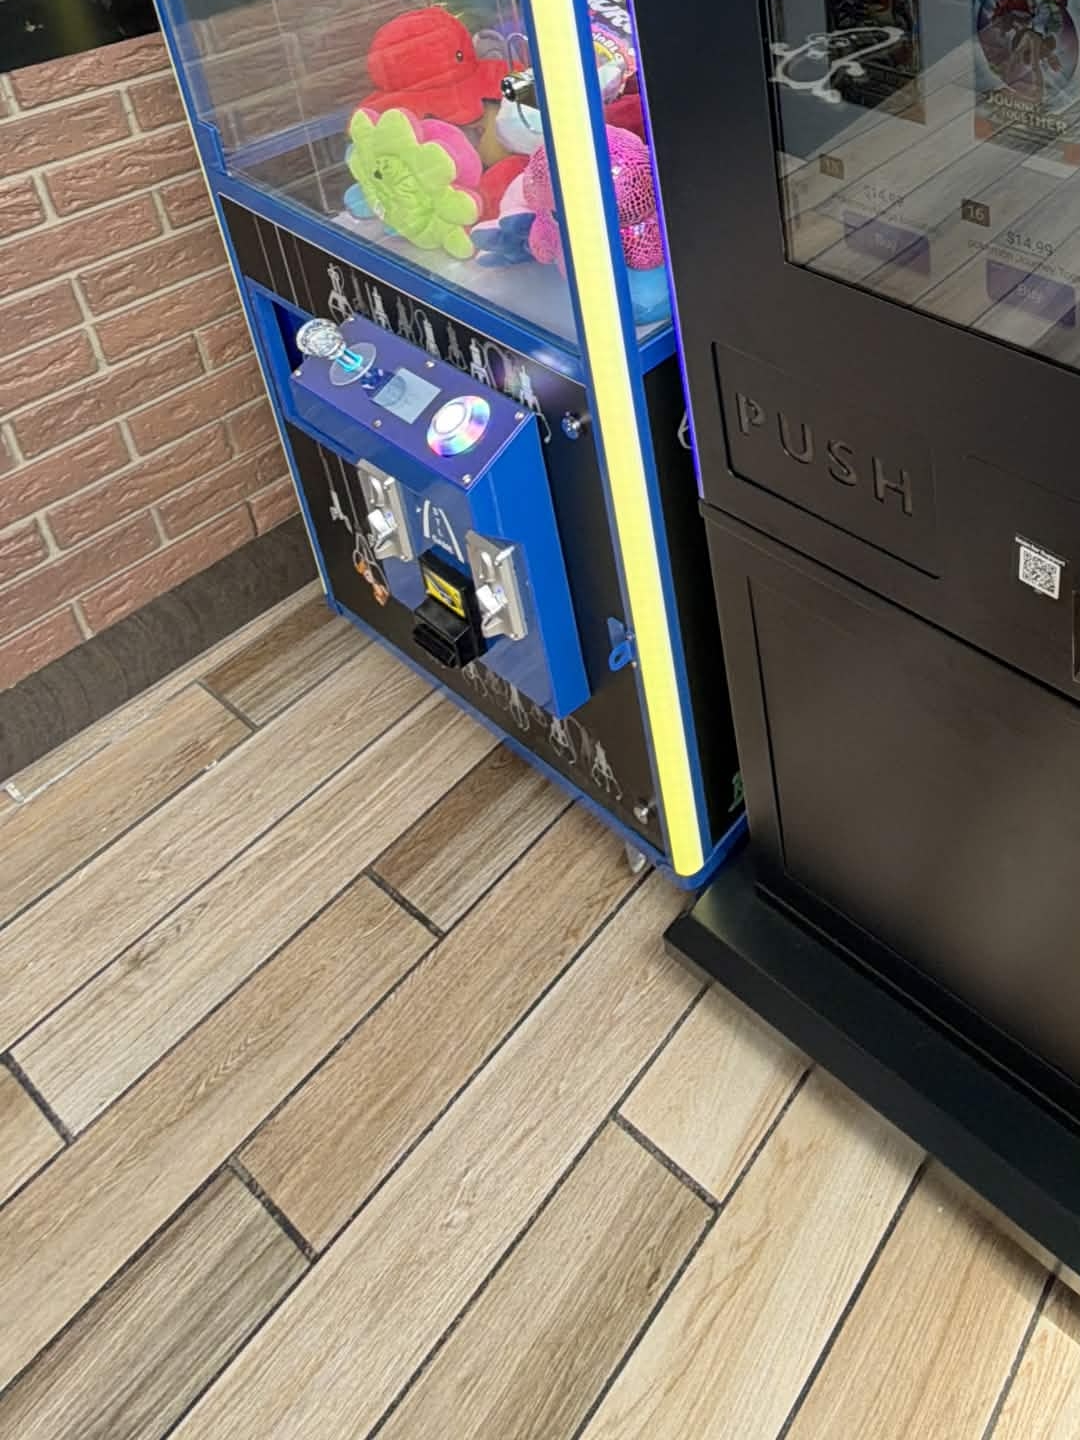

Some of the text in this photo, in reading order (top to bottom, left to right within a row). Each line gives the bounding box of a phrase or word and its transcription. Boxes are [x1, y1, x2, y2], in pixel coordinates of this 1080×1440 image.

[967, 206, 985, 221] 16
[1006, 230, 1053, 256] $14.99
[735, 391, 913, 519] PUSH
